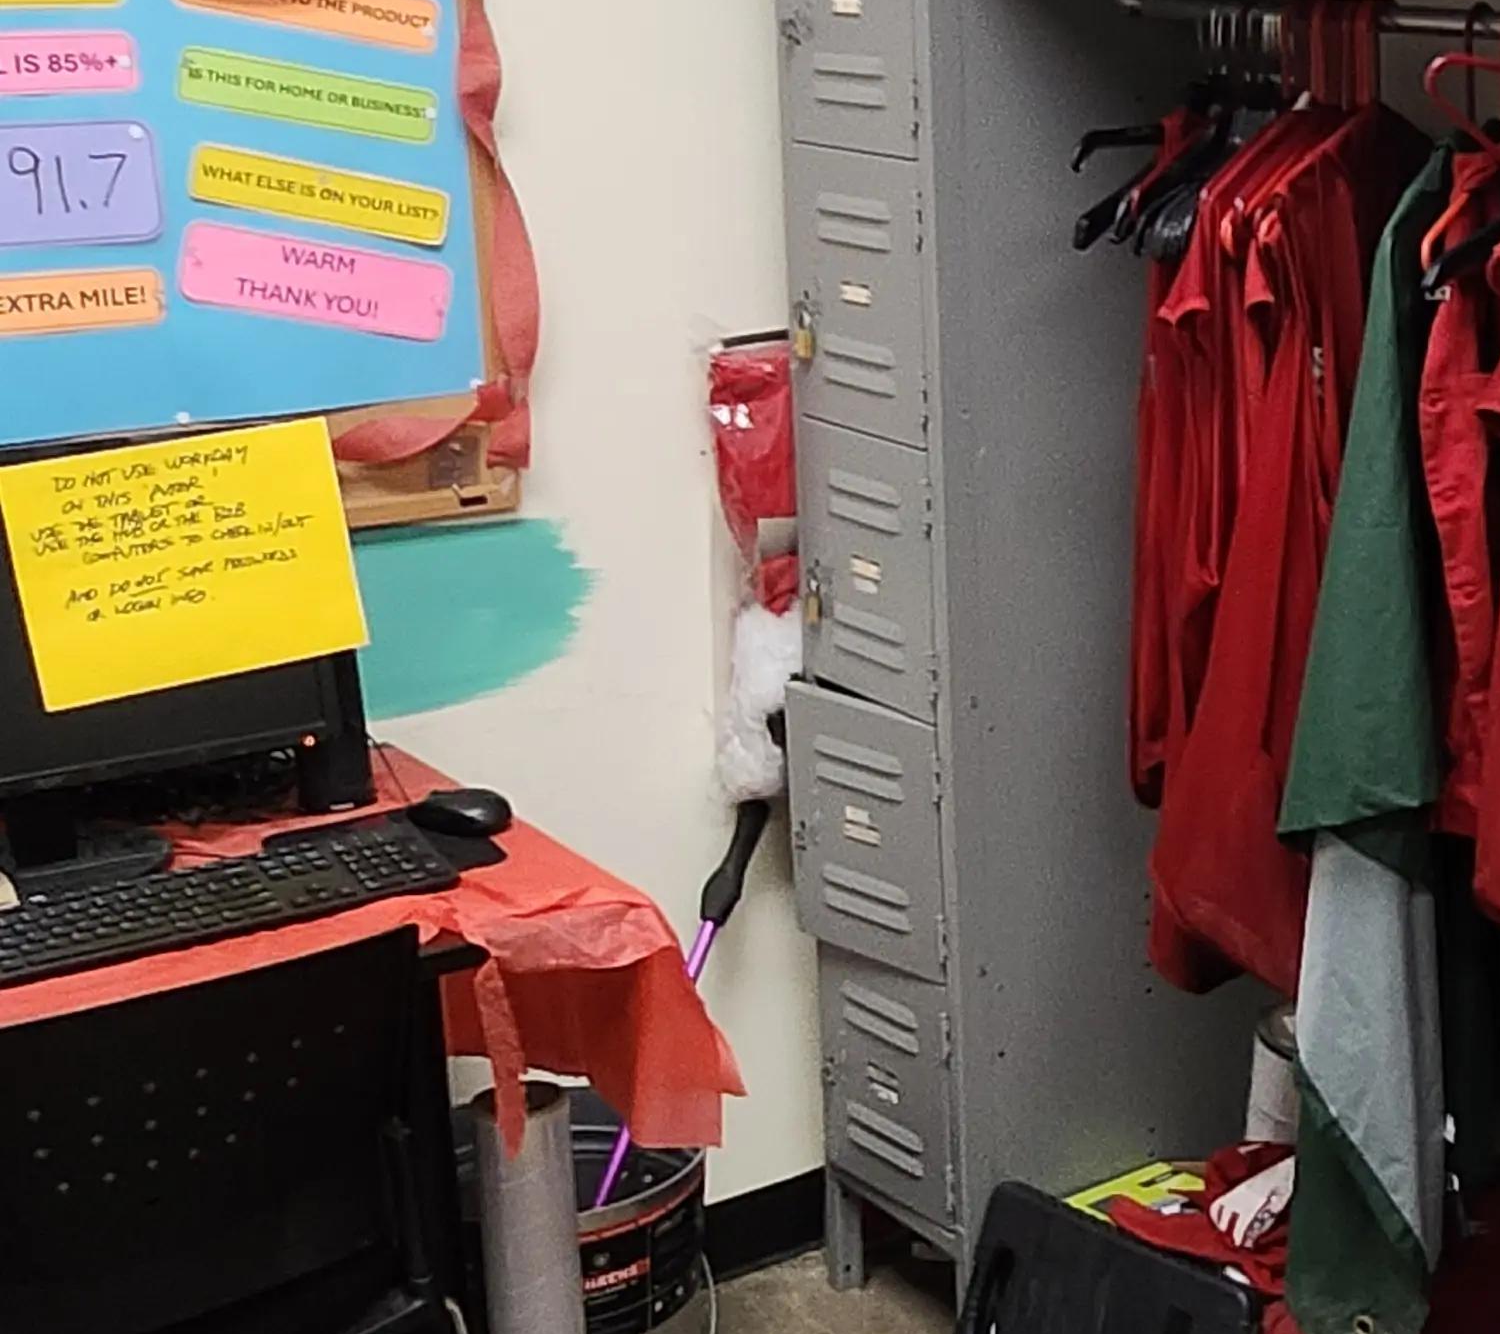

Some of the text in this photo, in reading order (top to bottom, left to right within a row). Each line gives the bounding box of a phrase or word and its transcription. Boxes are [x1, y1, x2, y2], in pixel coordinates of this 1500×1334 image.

[351, 1, 431, 29] PRODUCT
[15, 52, 117, 73] IS 85%+
[188, 67, 203, 79] IS
[207, 69, 242, 87] THIS
[245, 77, 276, 92] FOR
[279, 83, 323, 102] HOME
[327, 92, 348, 105] OR
[9, 145, 127, 216] 91.7
[201, 163, 440, 221] WHAT ELSE IS ON YOUR LIST?
[282, 244, 357, 276] WARM
[0, 285, 147, 315] EXTRA MILE!
[236, 277, 379, 320] THANK YOU!
[53, 445, 249, 493] DO NOT USE WORKDAY
[62, 491, 132, 515] ON THIS
[30, 526, 65, 543] USE
[71, 519, 104, 533] THE
[35, 540, 68, 557] USE
[75, 533, 104, 548] THE
[64, 588, 98, 610] AND
[109, 580, 131, 597] DO
[134, 567, 171, 589] NOT
